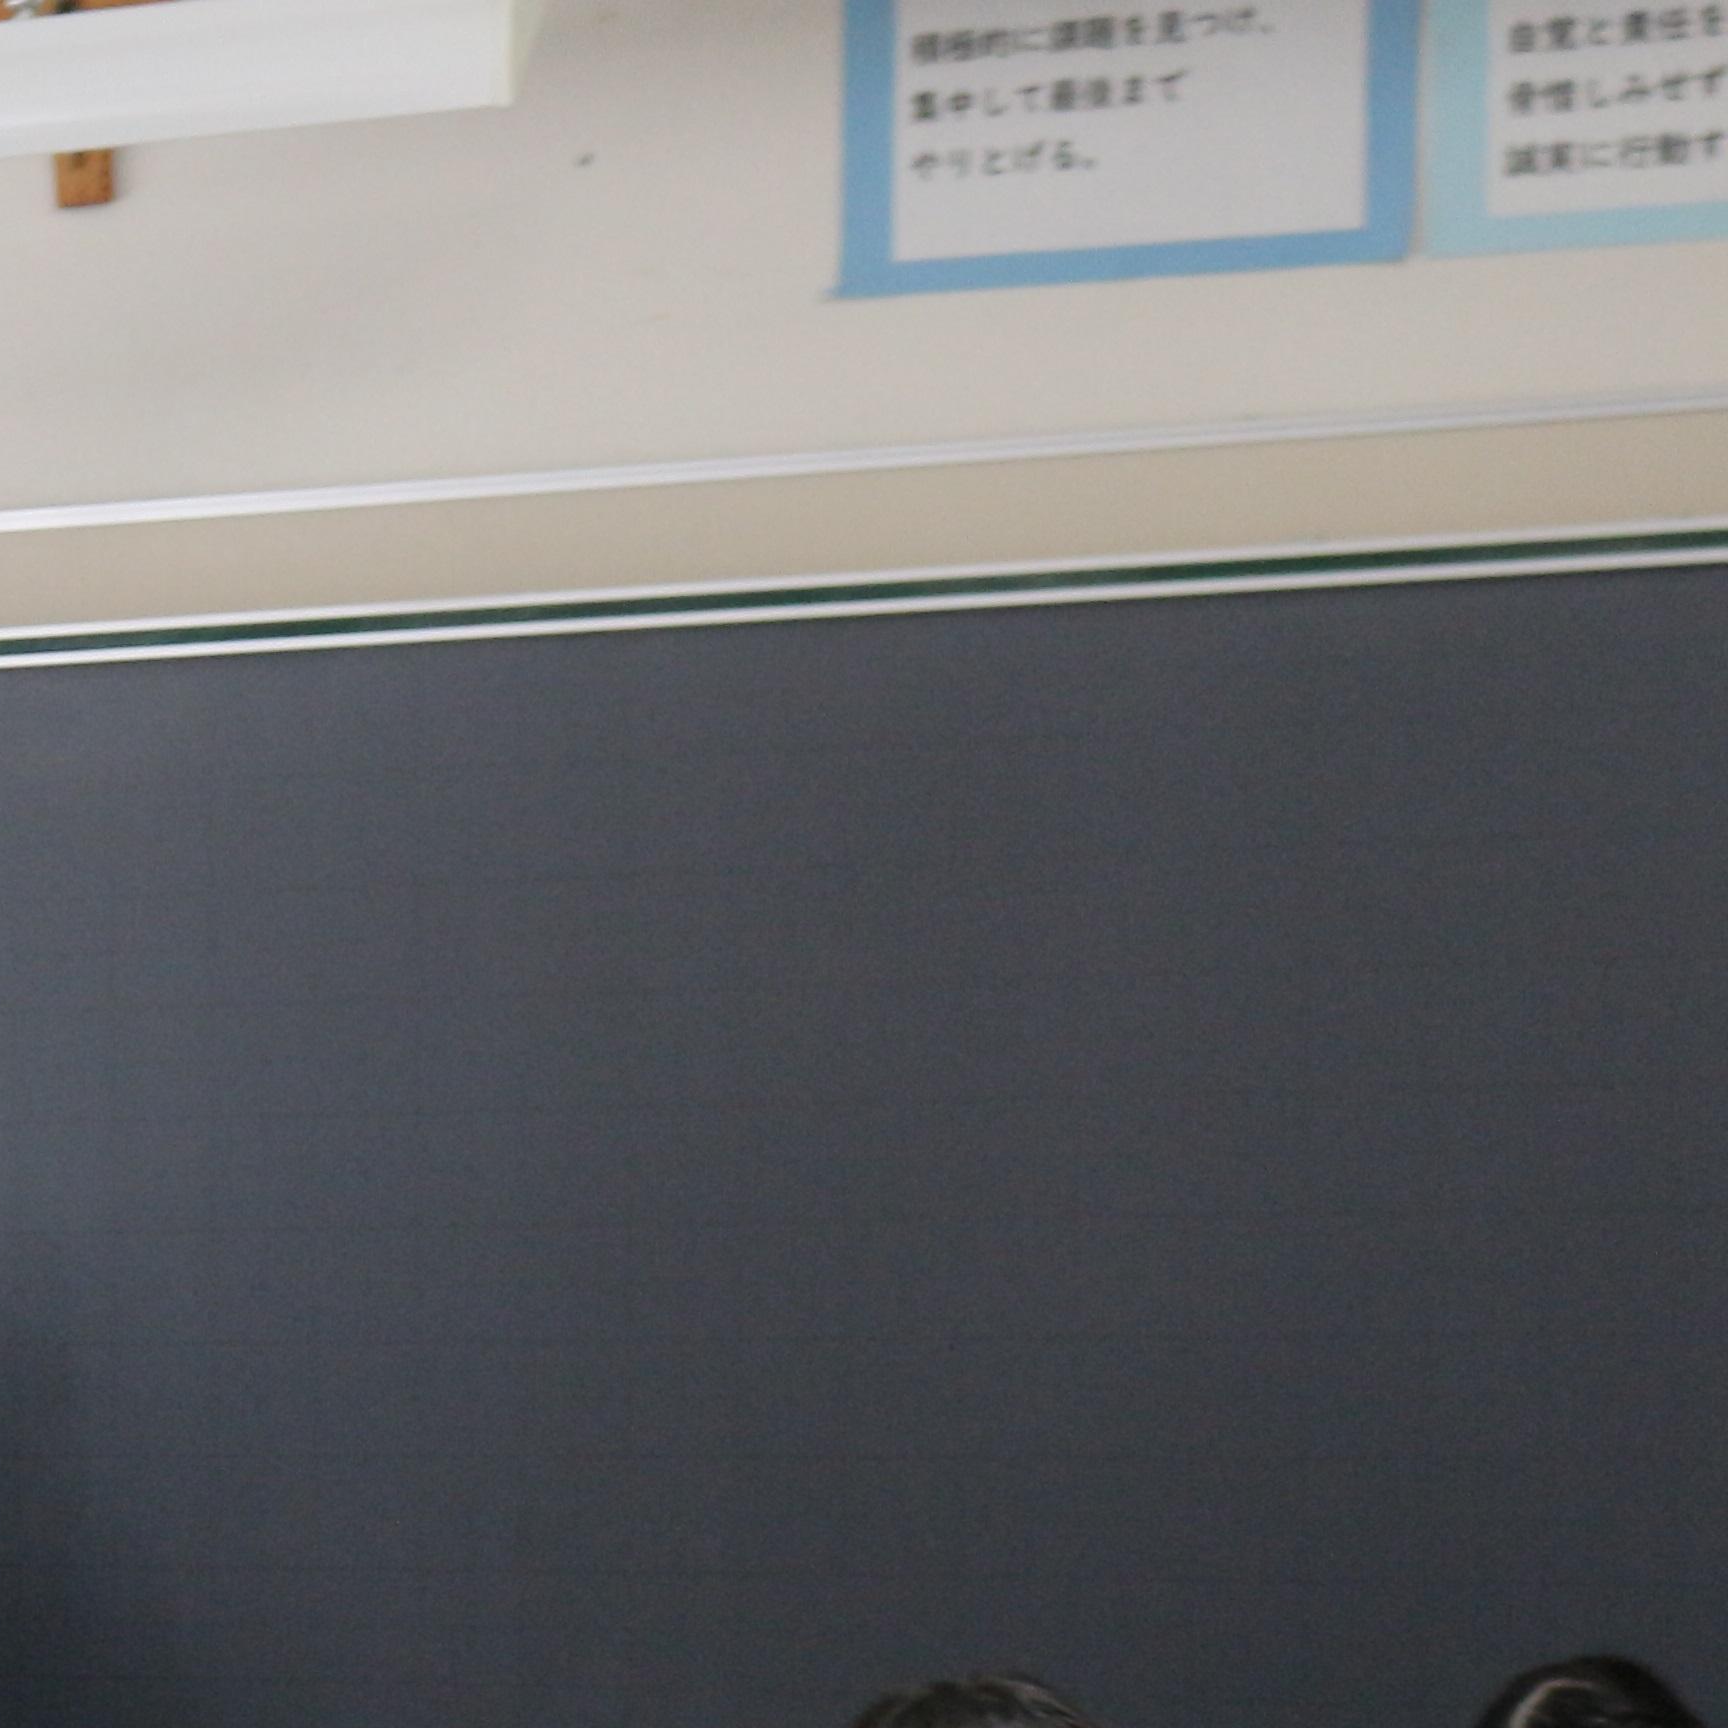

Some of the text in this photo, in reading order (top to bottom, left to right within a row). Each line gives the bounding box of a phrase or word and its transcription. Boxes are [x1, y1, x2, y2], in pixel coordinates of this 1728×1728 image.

[912, 70, 1188, 121] 集中して最後まで
[912, 139, 1096, 178] やりとげる。
